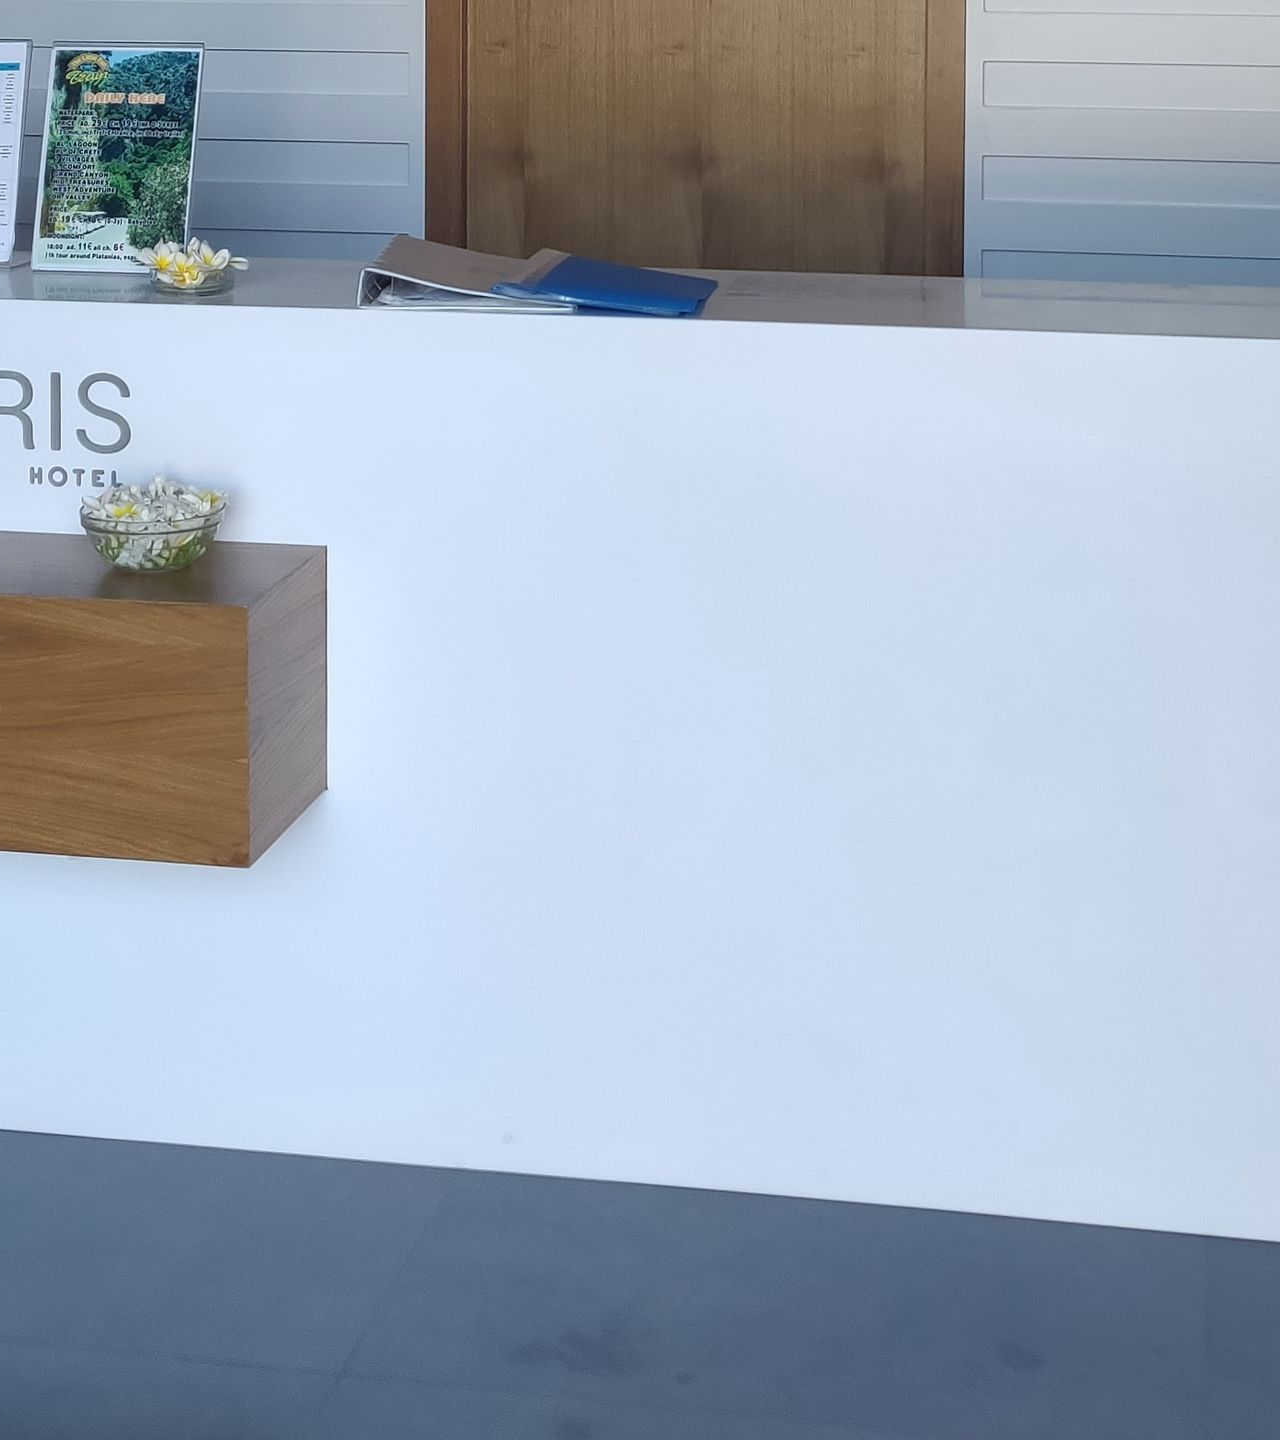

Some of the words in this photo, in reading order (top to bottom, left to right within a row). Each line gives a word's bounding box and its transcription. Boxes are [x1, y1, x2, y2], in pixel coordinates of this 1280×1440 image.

[78, 242, 92, 250] 11€
[113, 243, 124, 251] 6€
[29, 465, 123, 488] HOTEL
